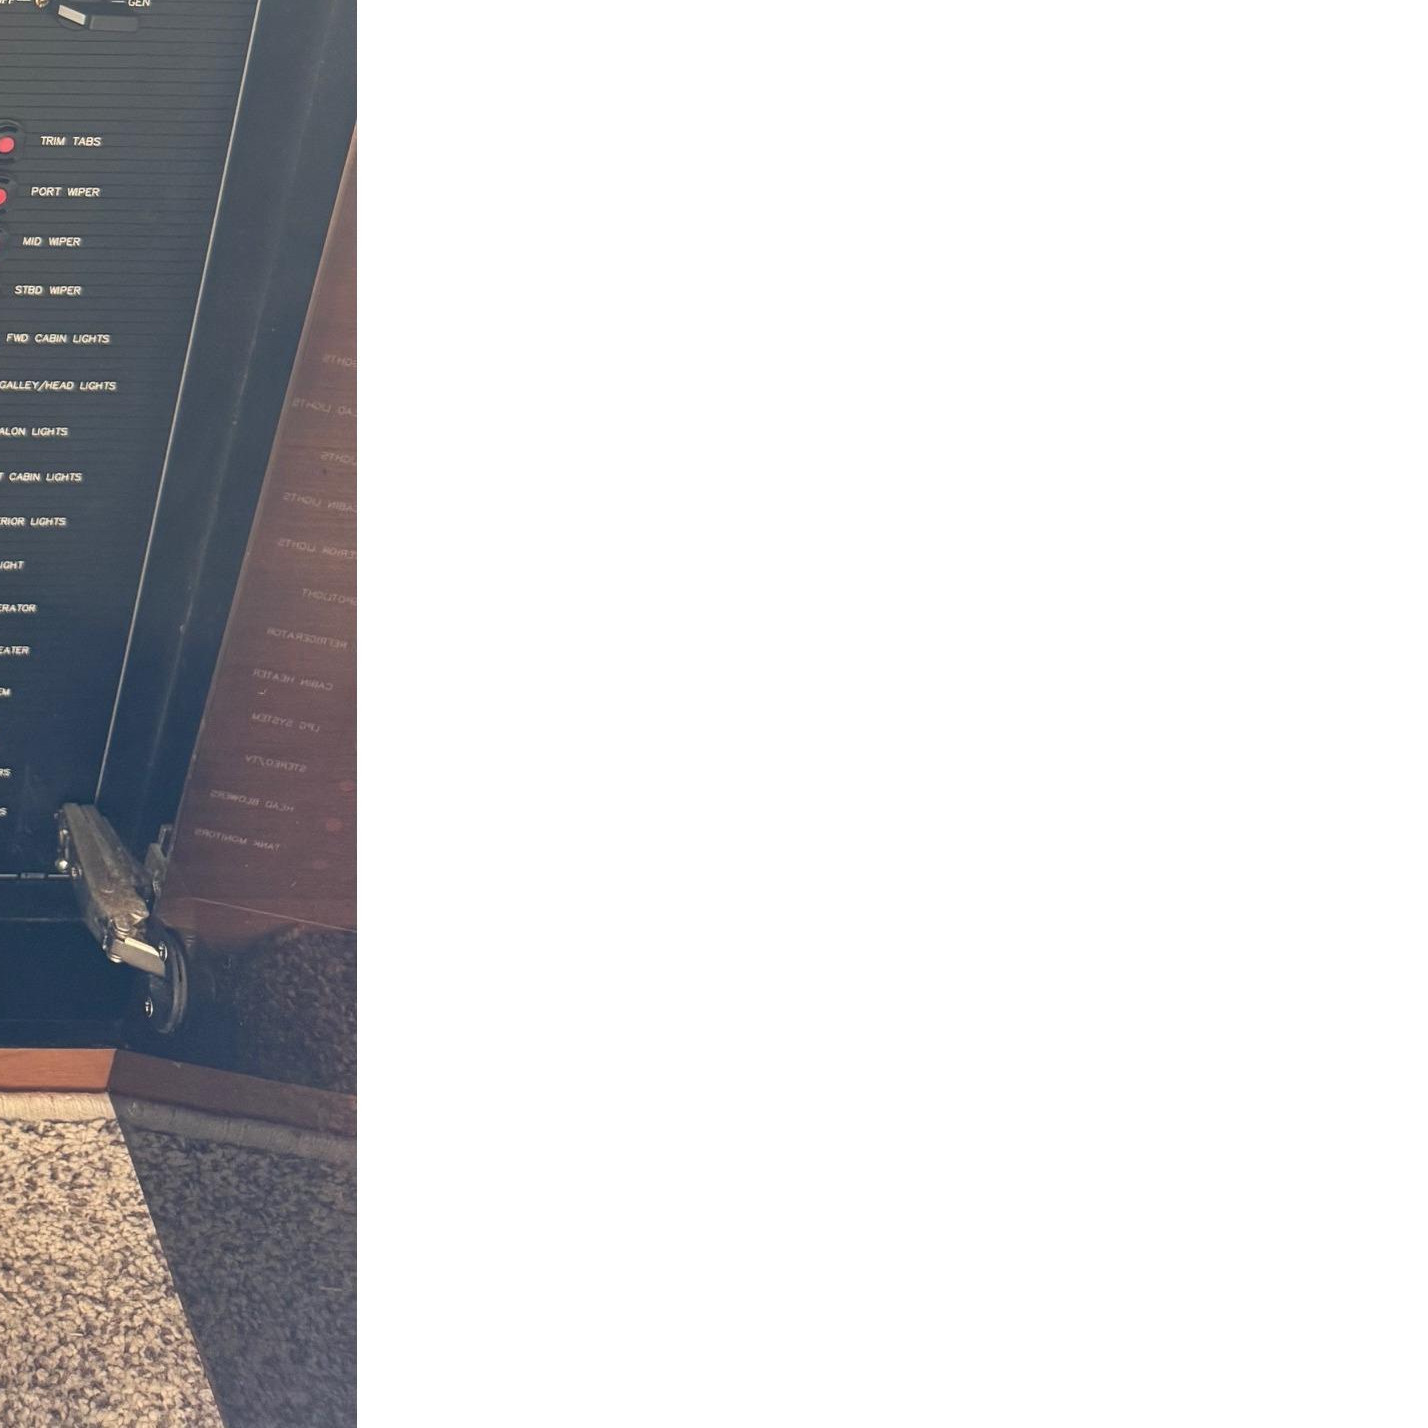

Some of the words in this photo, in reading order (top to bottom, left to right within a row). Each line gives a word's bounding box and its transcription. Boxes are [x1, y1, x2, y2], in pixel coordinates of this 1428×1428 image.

[40, 136, 66, 146] TRIM
[73, 137, 101, 147] TABS
[80, 381, 117, 391] LIGHTS
